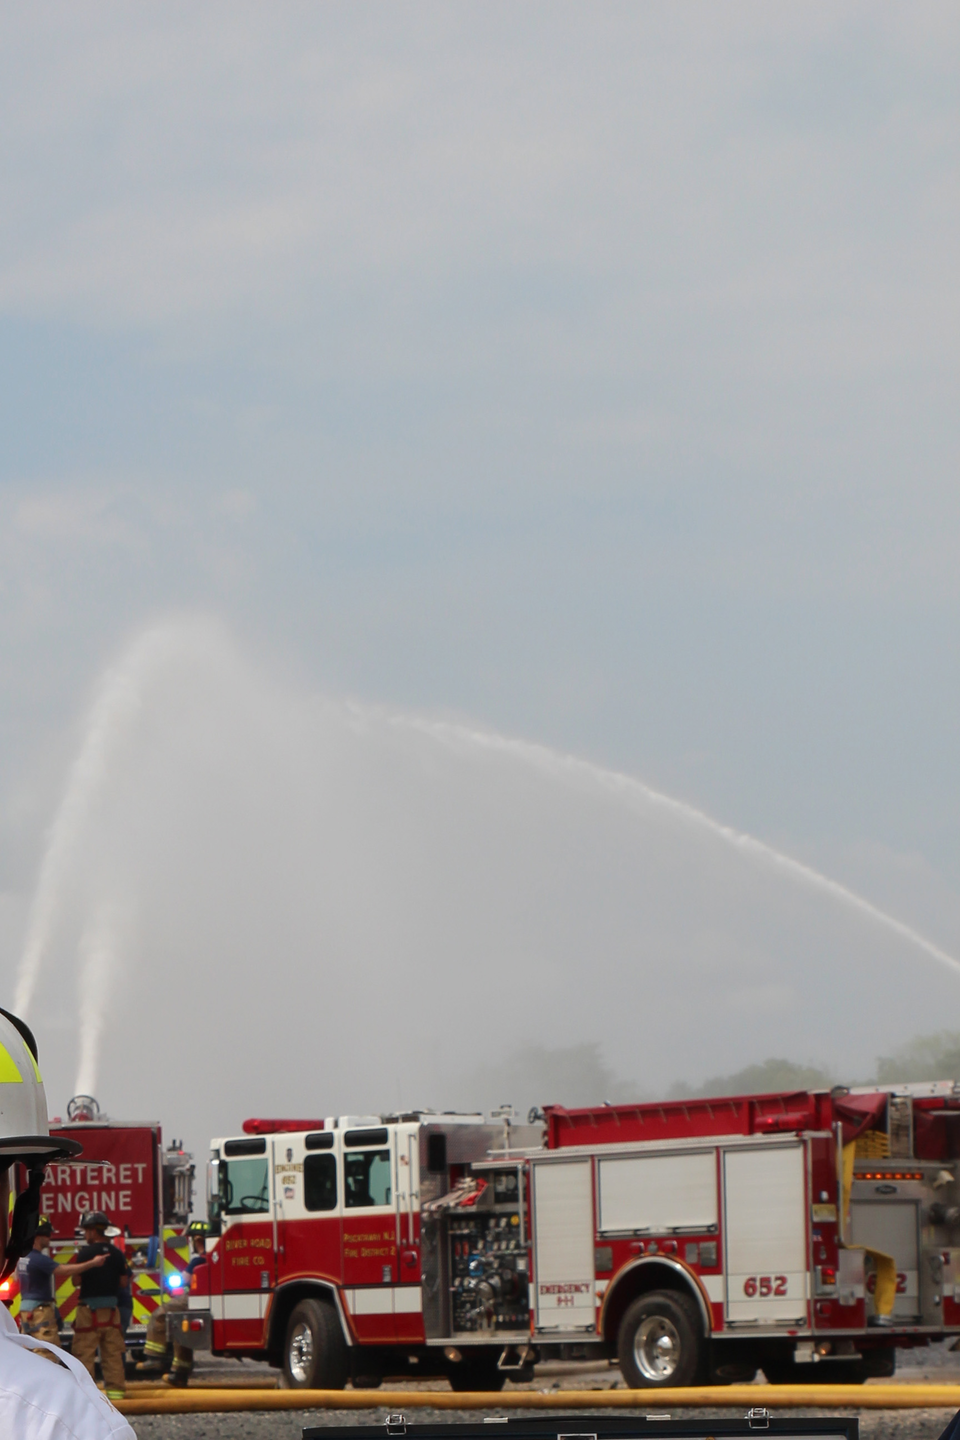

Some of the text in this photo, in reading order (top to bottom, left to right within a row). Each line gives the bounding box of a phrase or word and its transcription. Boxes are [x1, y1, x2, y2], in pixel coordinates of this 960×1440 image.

[42, 1190, 132, 1213] ENGINE
[743, 1276, 788, 1298] 652
[867, 1273, 907, 1294] 62
